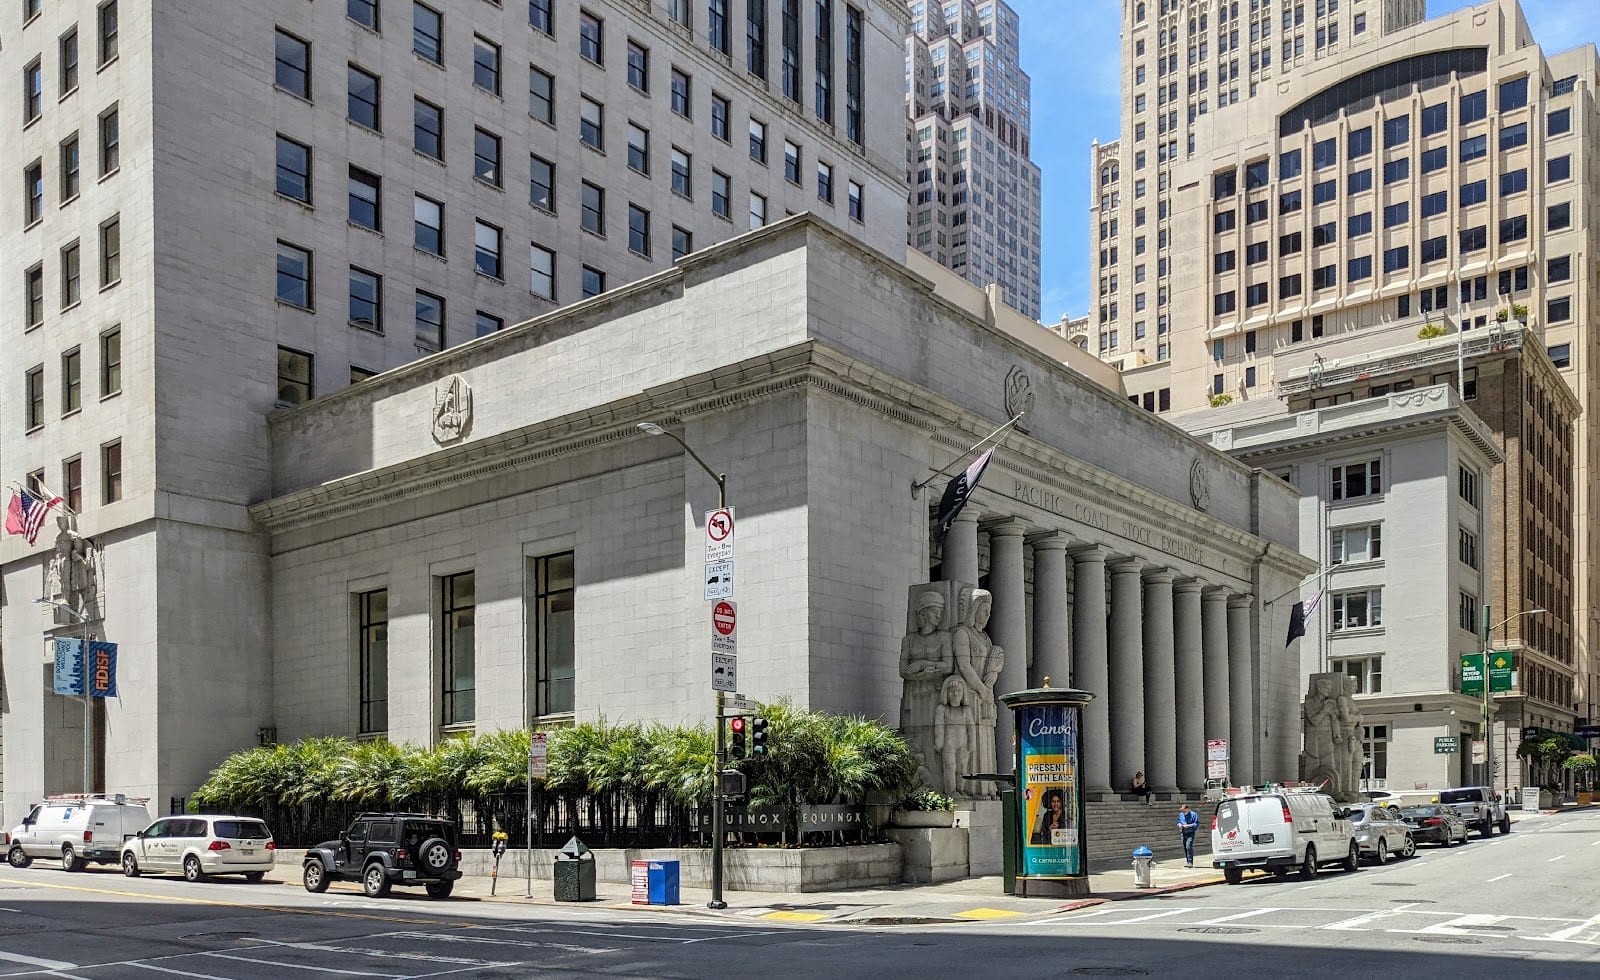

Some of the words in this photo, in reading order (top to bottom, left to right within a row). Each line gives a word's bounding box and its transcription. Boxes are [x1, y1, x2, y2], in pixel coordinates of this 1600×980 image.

[1014, 480, 1063, 513] PACIFIC
[1075, 503, 1112, 530] COAST
[1121, 521, 1152, 545] STOCK
[1161, 536, 1204, 565] EXCHANGE
[707, 550, 731, 559] EVERYDAY
[708, 564, 729, 573] EXCEPT
[717, 621, 731, 629] ENTER
[715, 656, 733, 664] EXCEPT
[1029, 718, 1071, 737] Canva
[1029, 763, 1066, 772] PRESENT
[1029, 773, 1050, 782] WITH
[1052, 773, 1073, 782] EASE
[703, 813, 780, 825] EUINOX
[802, 812, 862, 824] EQUINOX
